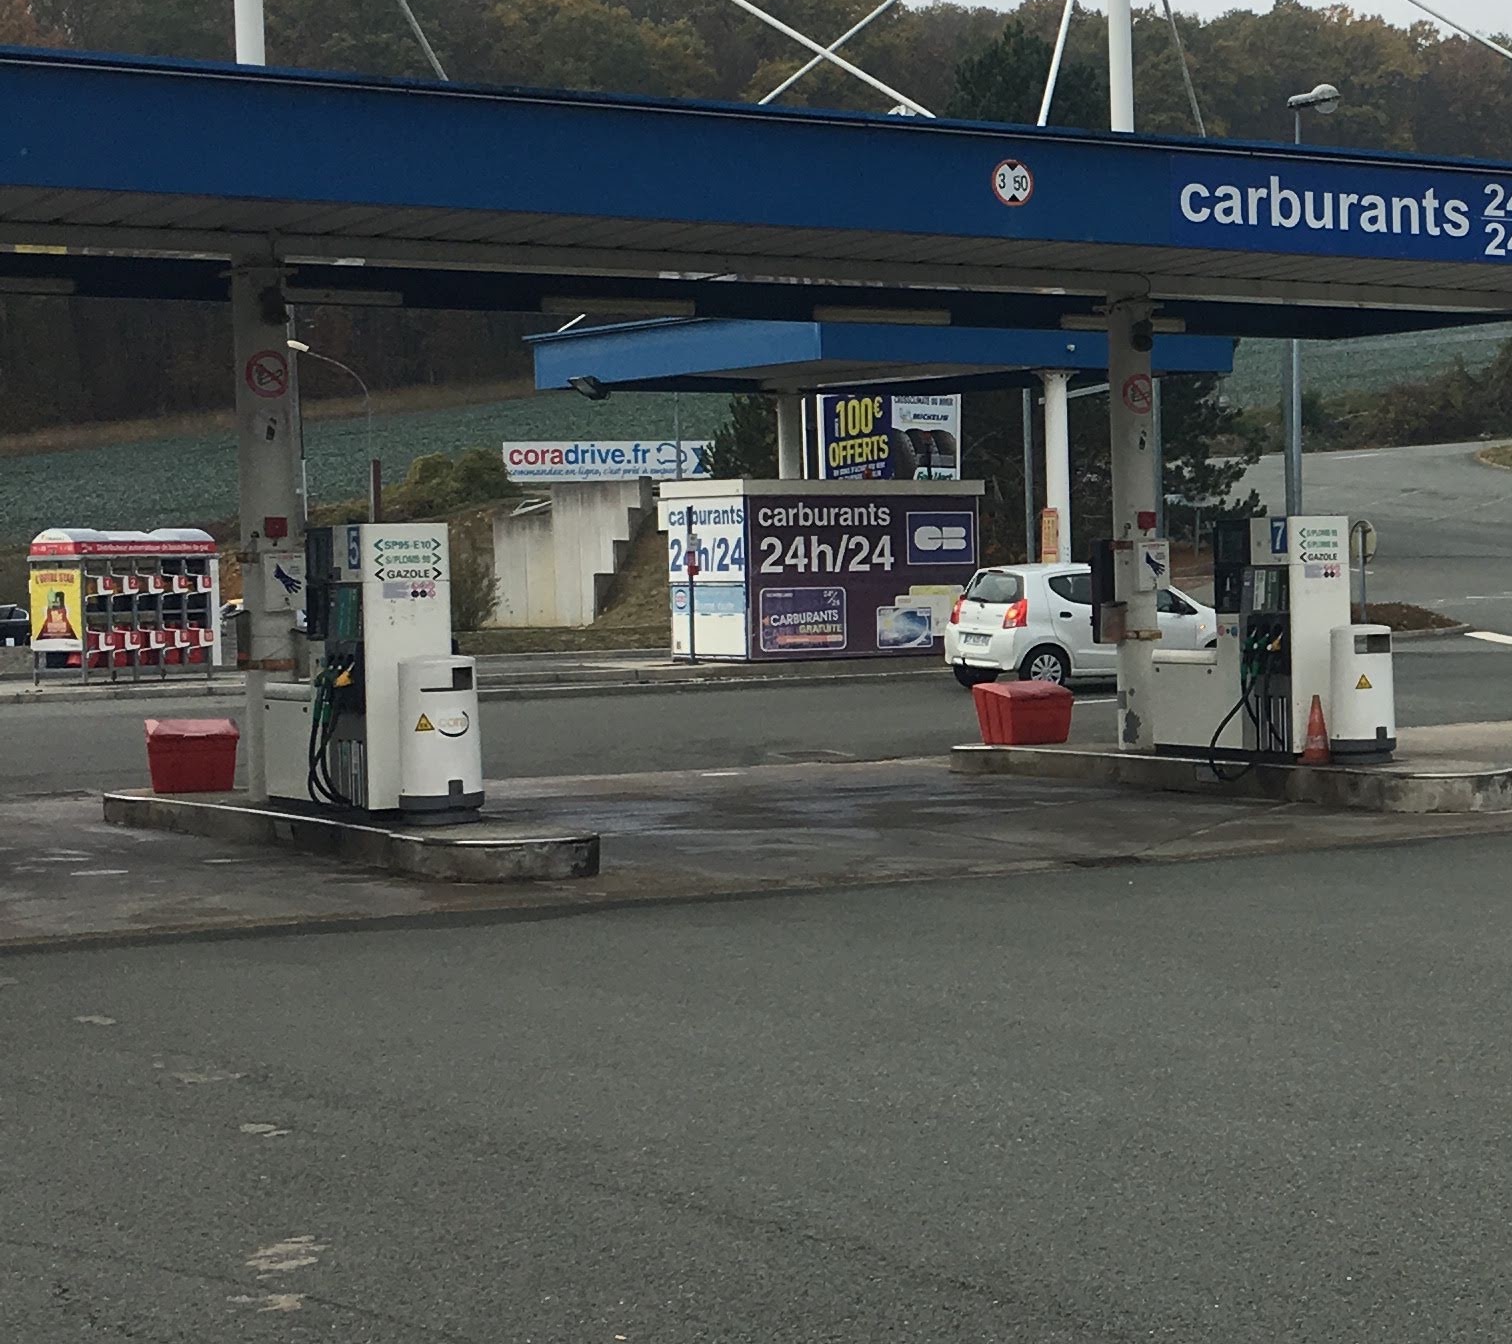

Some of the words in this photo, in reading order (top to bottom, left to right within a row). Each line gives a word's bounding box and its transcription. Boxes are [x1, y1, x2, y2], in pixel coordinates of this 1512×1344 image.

[999, 173, 1006, 189] 3
[1013, 175, 1028, 192] 50
[1180, 175, 1470, 237] carburants
[508, 443, 651, 466] coradrive.fr
[828, 435, 889, 468] OFFERTS
[758, 502, 891, 527] carburants
[350, 529, 359, 565] 5
[1272, 521, 1285, 550] 7
[760, 534, 895, 574] 24h/24
[1308, 553, 1338, 561] GAZOLE
[386, 569, 430, 579] GAZOLE
[770, 609, 839, 627] CARBURANTS
